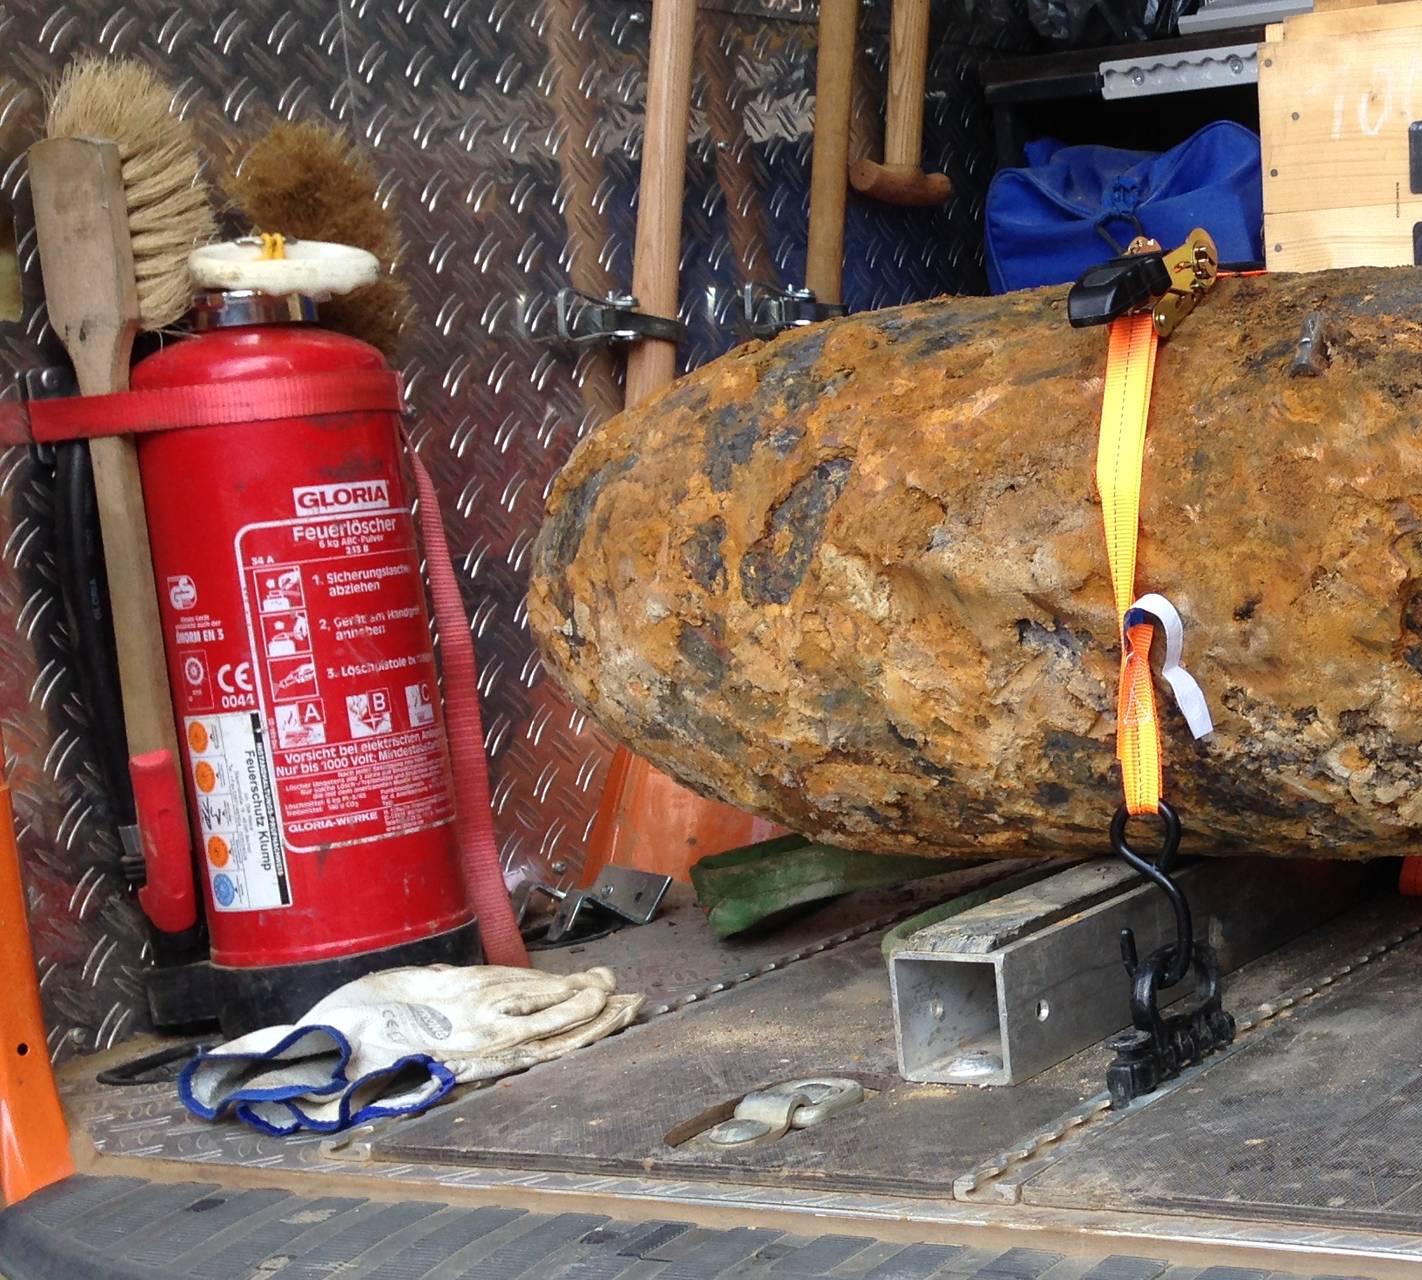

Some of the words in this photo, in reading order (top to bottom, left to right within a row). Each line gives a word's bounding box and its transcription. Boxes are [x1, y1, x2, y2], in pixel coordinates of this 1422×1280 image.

[297, 486, 387, 509] GLORIA
[293, 518, 397, 542] Feuerlöscher
[318, 540, 326, 549] 6
[327, 540, 339, 549] kg
[266, 555, 275, 564] A
[312, 574, 324, 585] 1.
[328, 581, 381, 597] abziehen
[319, 619, 331, 631] 2.
[216, 628, 225, 641] 3
[326, 667, 338, 679] 3.
[221, 693, 255, 708] 0044
[304, 705, 321, 723] A
[372, 692, 386, 712] B
[420, 683, 430, 701] C
[284, 747, 338, 765] Vorsicht
[339, 742, 358, 756] bei
[361, 732, 421, 754] elektrischen
[276, 765, 299, 777] Nur
[301, 761, 319, 774] bis
[321, 757, 348, 771] 1000
[244, 750, 265, 828] Feuerschutz
[257, 829, 272, 872] Klump
[288, 811, 378, 833] GLORIA-WERKE
